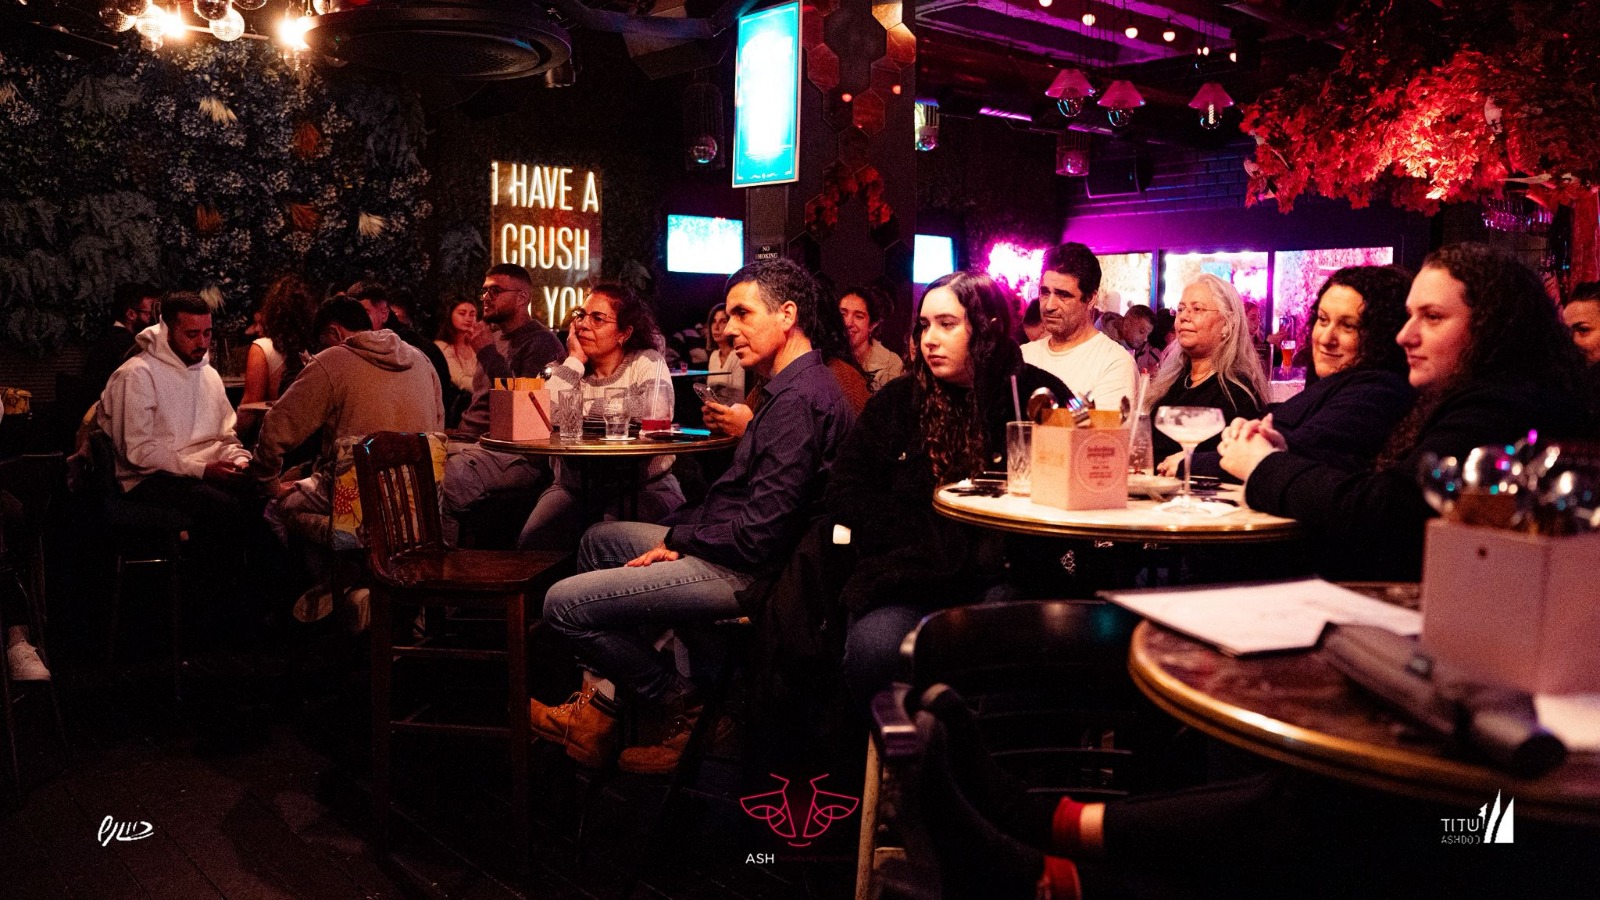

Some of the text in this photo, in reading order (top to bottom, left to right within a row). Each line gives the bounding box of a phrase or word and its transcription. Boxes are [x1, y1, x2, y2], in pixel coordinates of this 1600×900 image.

[491, 161, 600, 213] I HAVE A
[501, 223, 590, 271] CRUSH
[755, 252, 778, 260] SMOKING
